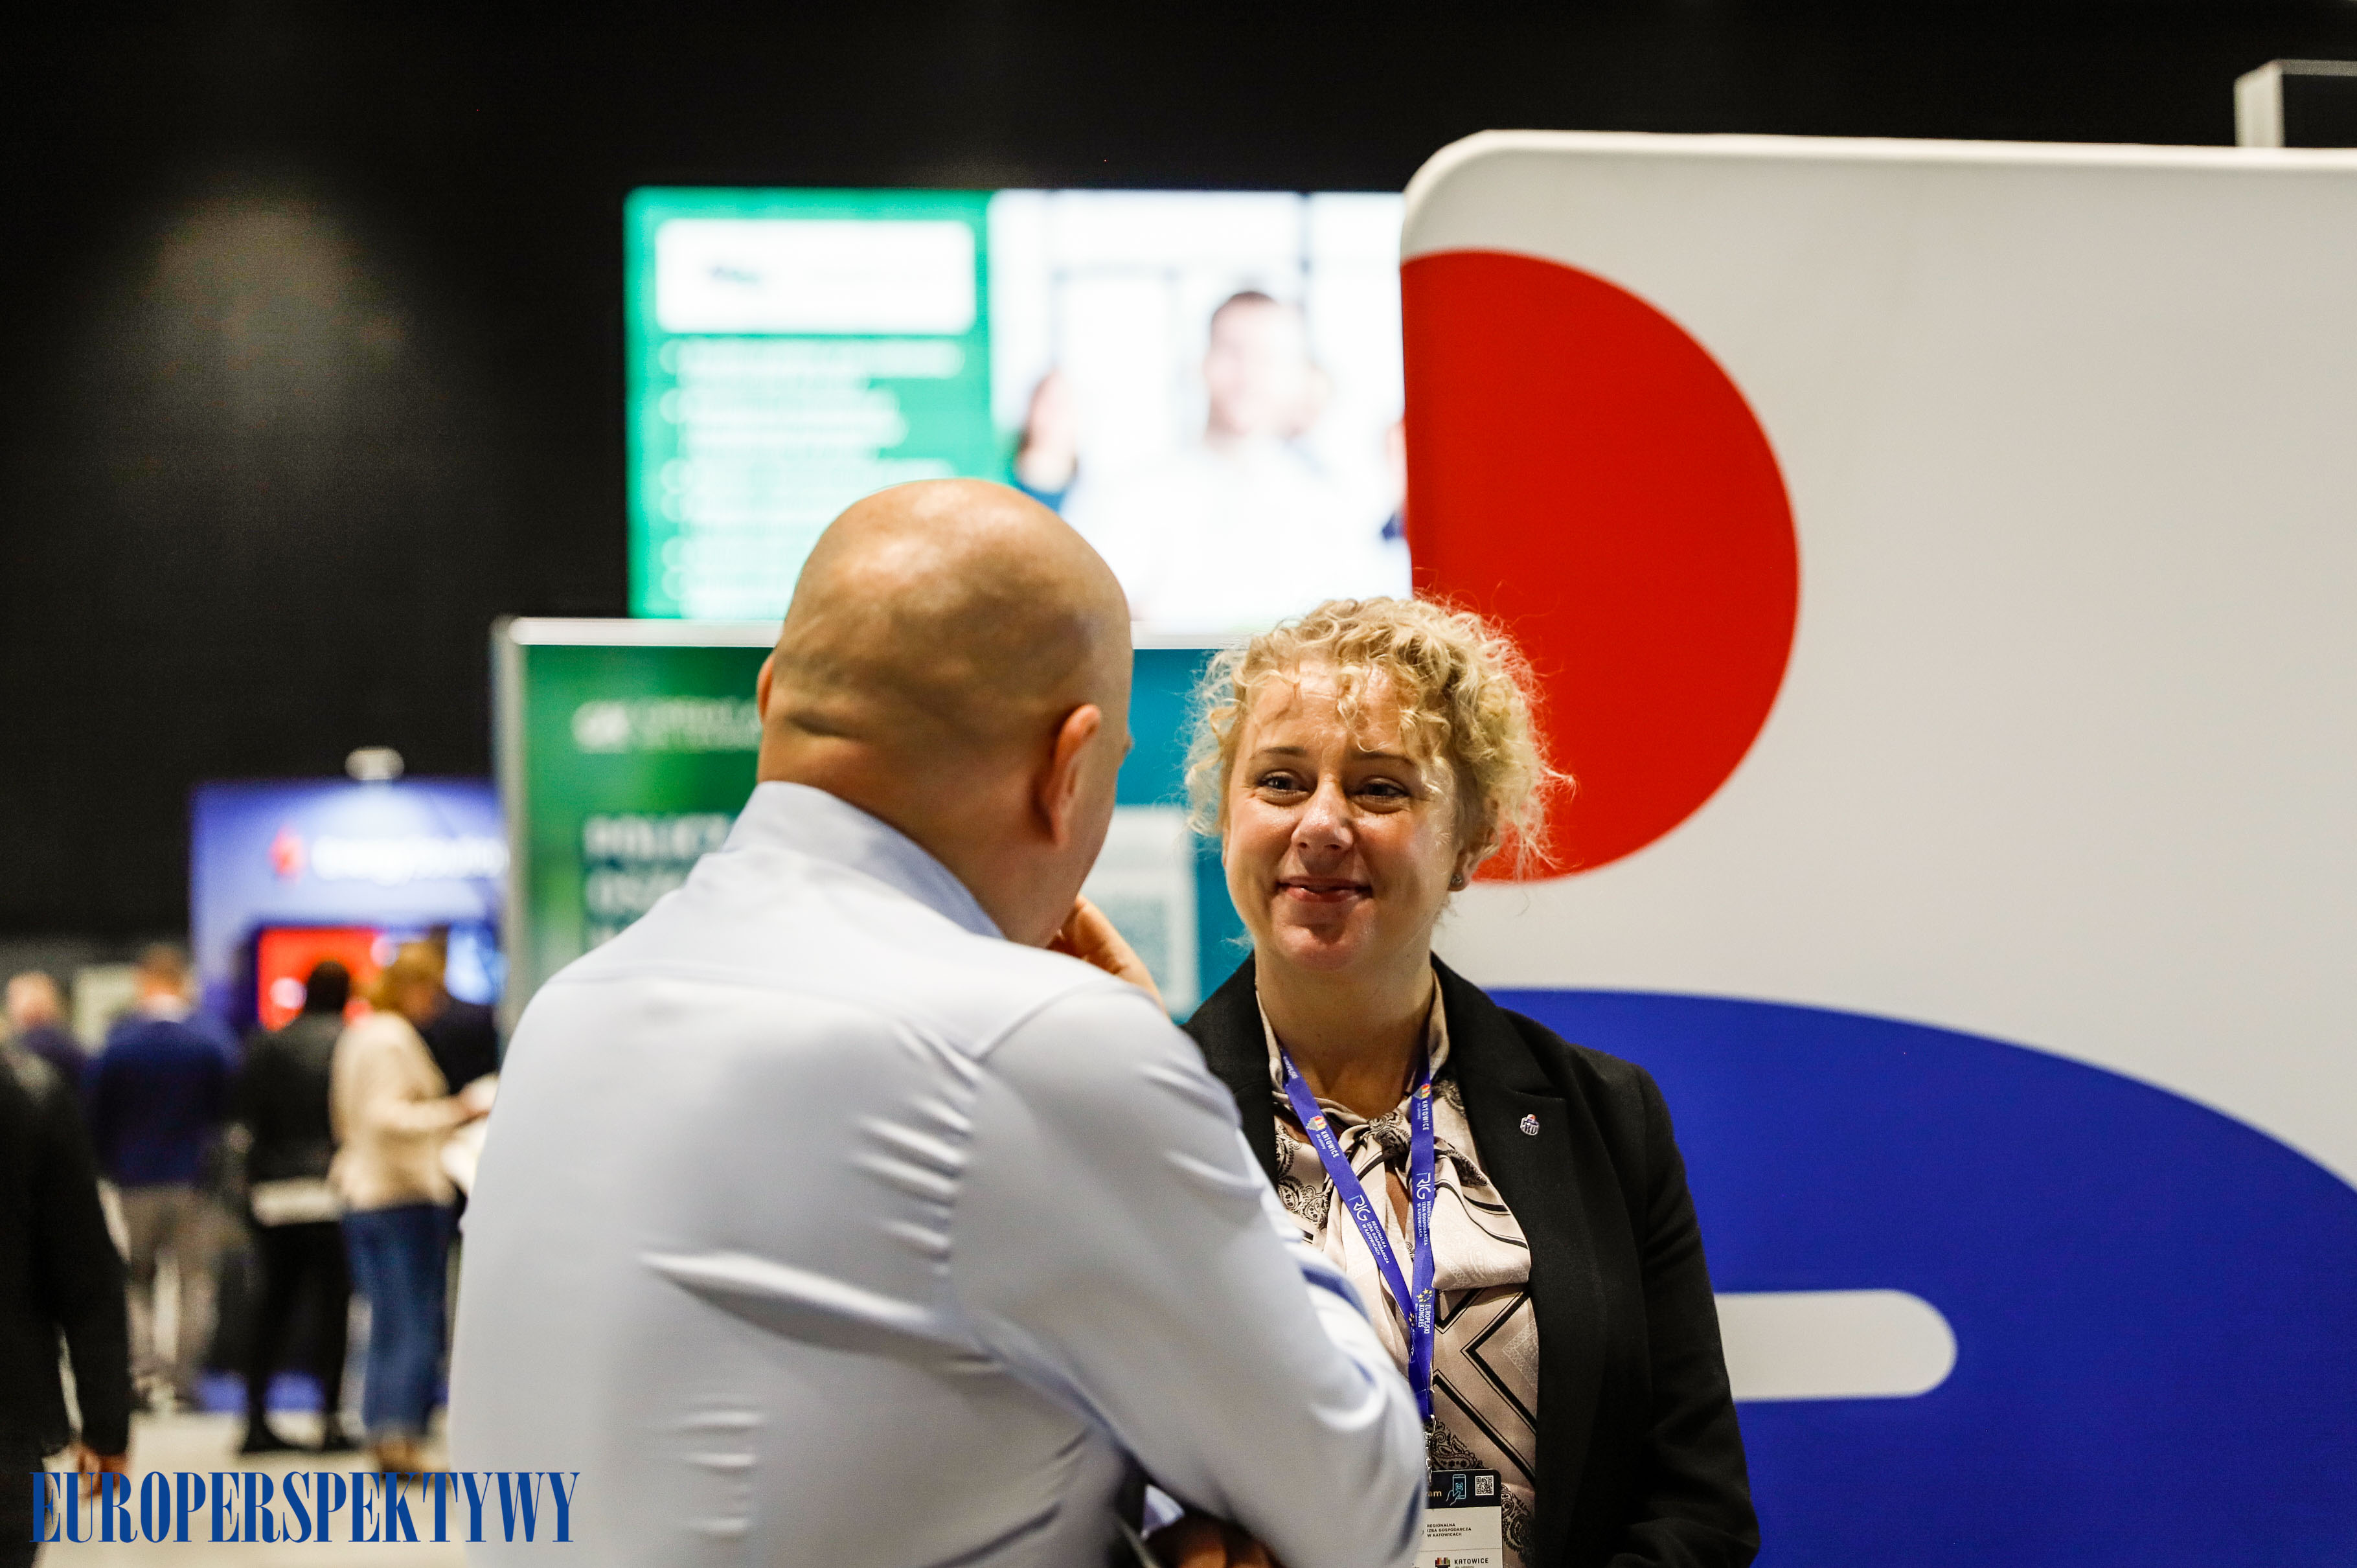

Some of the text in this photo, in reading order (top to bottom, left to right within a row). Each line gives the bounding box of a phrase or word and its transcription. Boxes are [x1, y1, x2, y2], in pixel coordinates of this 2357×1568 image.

[1320, 1131, 1339, 1158] KATOWICE
[1416, 1172, 1431, 1199] RIG
[1348, 1194, 1371, 1221] RIG
[1365, 1228, 1381, 1255] KATOWICACH
[1371, 1220, 1387, 1248] REGIONALNA
[1372, 1231, 1389, 1264] GOSPODARCZA
